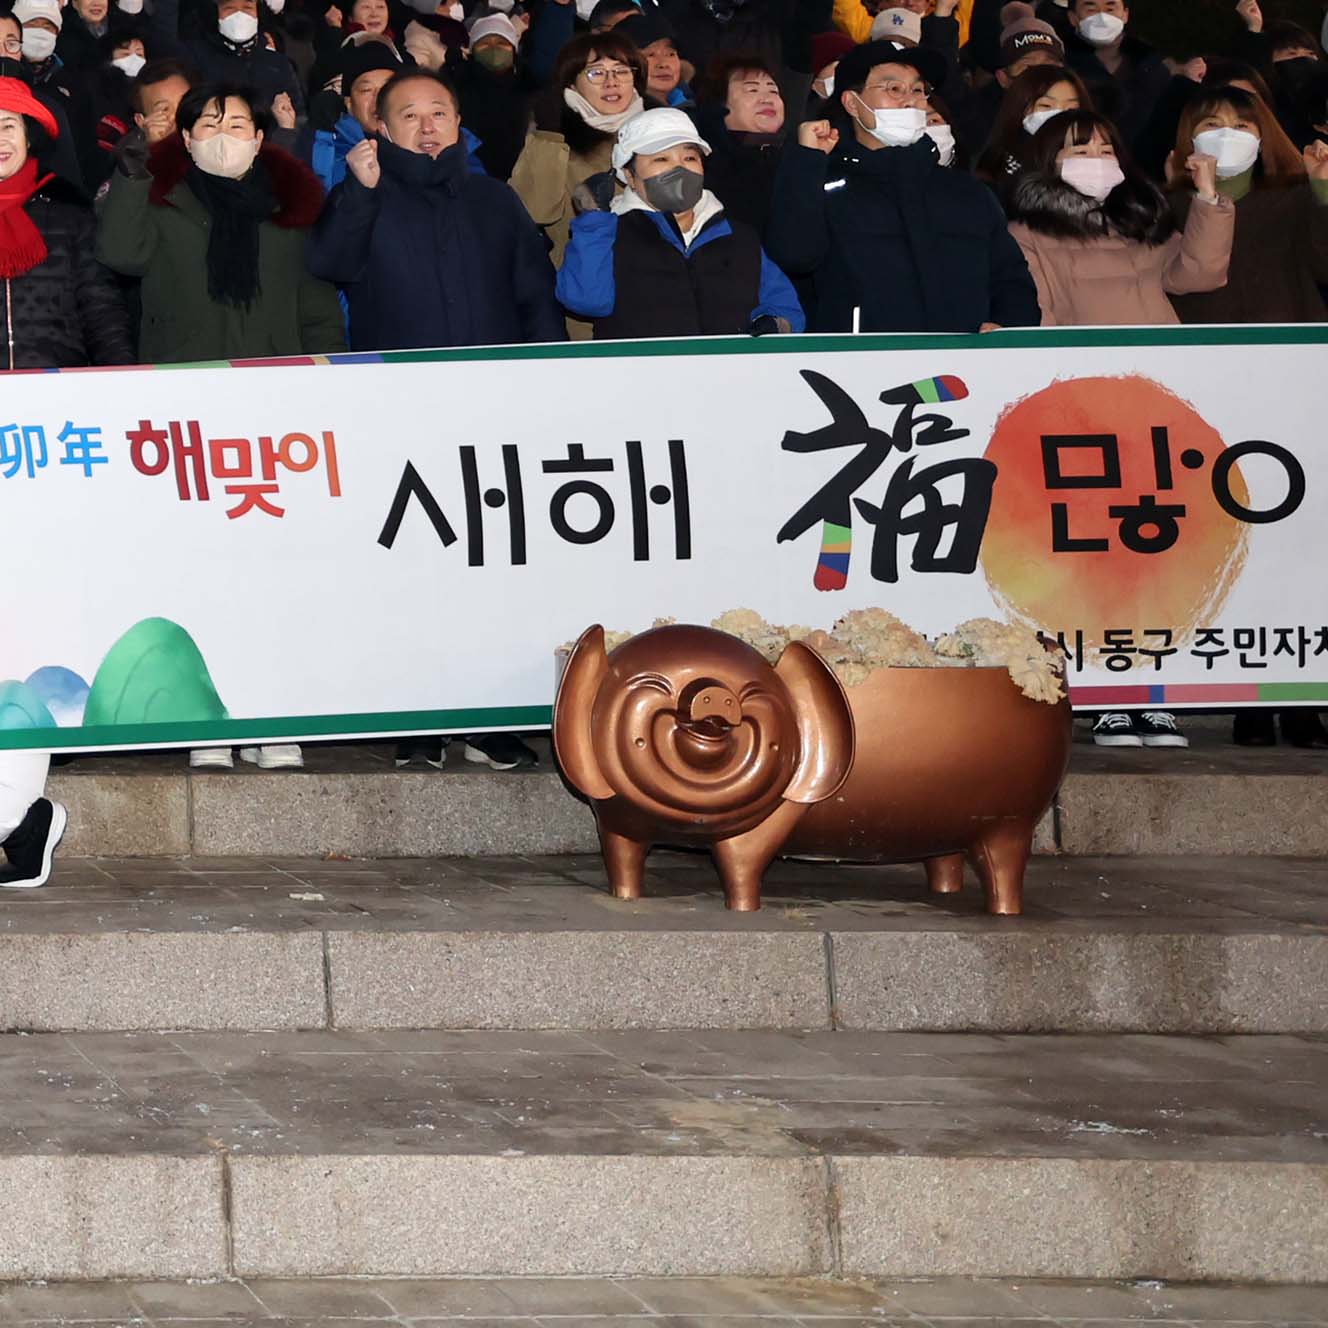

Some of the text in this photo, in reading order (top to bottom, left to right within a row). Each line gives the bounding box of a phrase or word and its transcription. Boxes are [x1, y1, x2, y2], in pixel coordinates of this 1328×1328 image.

[125, 419, 342, 520] 해맞이
[377, 439, 693, 567] 새해
[776, 369, 998, 592] 福
[1099, 629, 1178, 672] 동구
